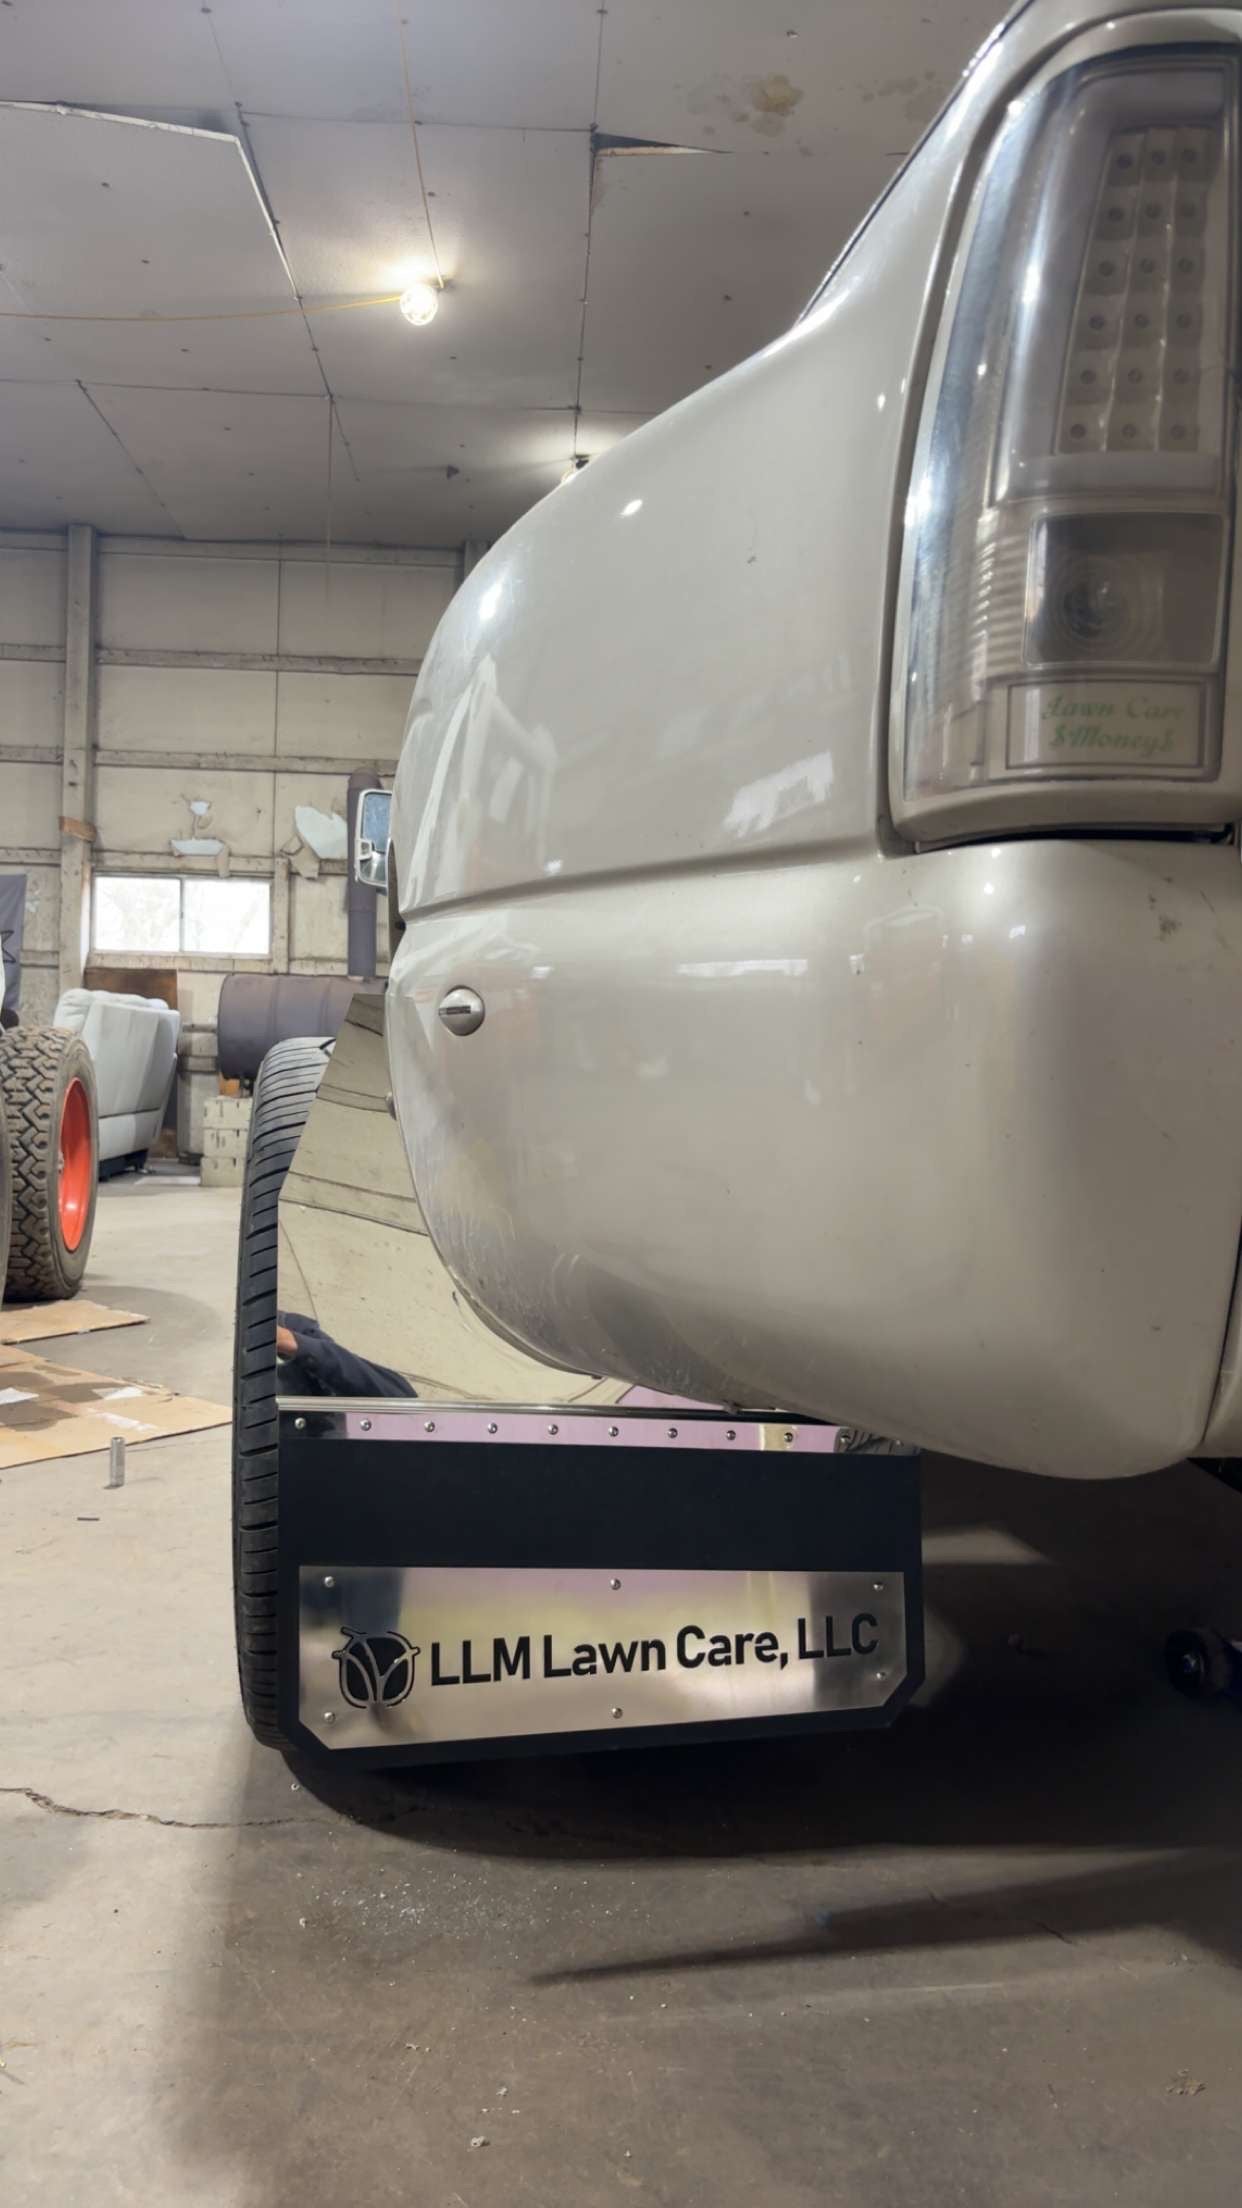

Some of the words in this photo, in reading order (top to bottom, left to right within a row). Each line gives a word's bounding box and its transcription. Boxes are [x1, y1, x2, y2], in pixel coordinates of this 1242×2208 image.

[431, 1636, 531, 1686] LLM
[543, 1634, 666, 1678] Lawn
[676, 1625, 789, 1671] Care,
[797, 1613, 879, 1660] LLC
